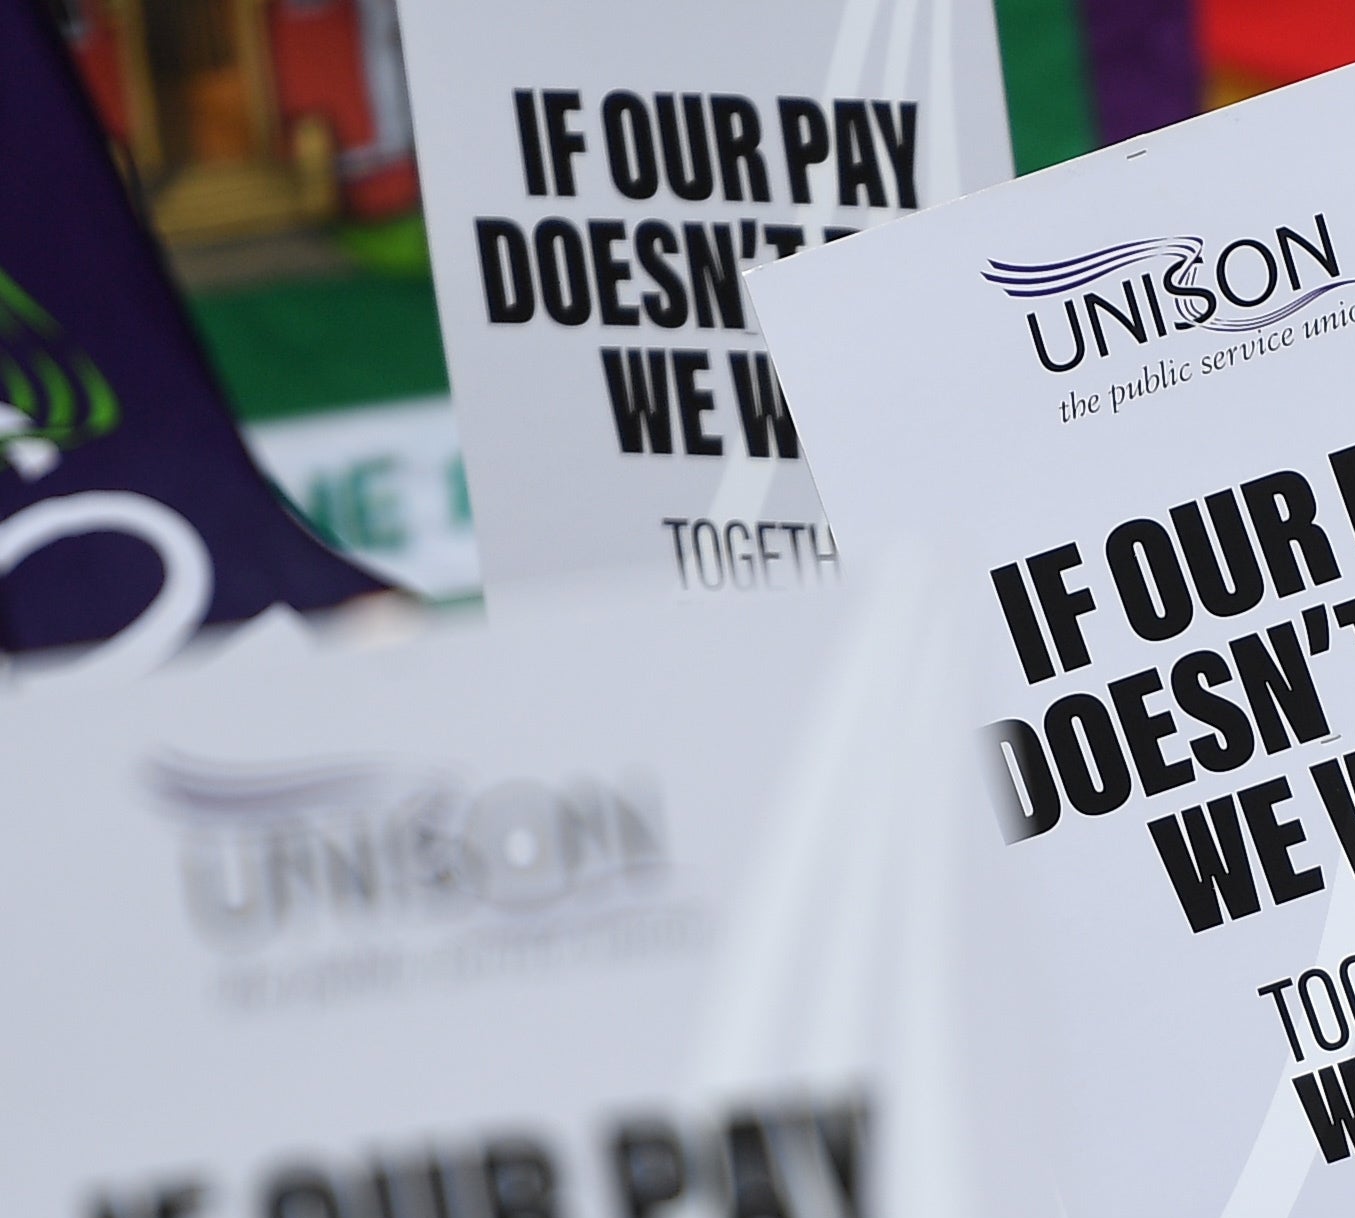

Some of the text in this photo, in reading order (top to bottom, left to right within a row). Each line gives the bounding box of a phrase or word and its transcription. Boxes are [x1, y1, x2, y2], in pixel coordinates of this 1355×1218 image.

[512, 88, 919, 211] IF OUR PAY
[1026, 212, 1341, 373] UNISON
[600, 346, 726, 457] WE
[1059, 392, 1102, 423] the
[1108, 361, 1194, 414] public
[1200, 323, 1296, 375] service
[989, 543, 1098, 685] IF
[1104, 470, 1343, 643] OUR
[1146, 777, 1327, 935] WE
